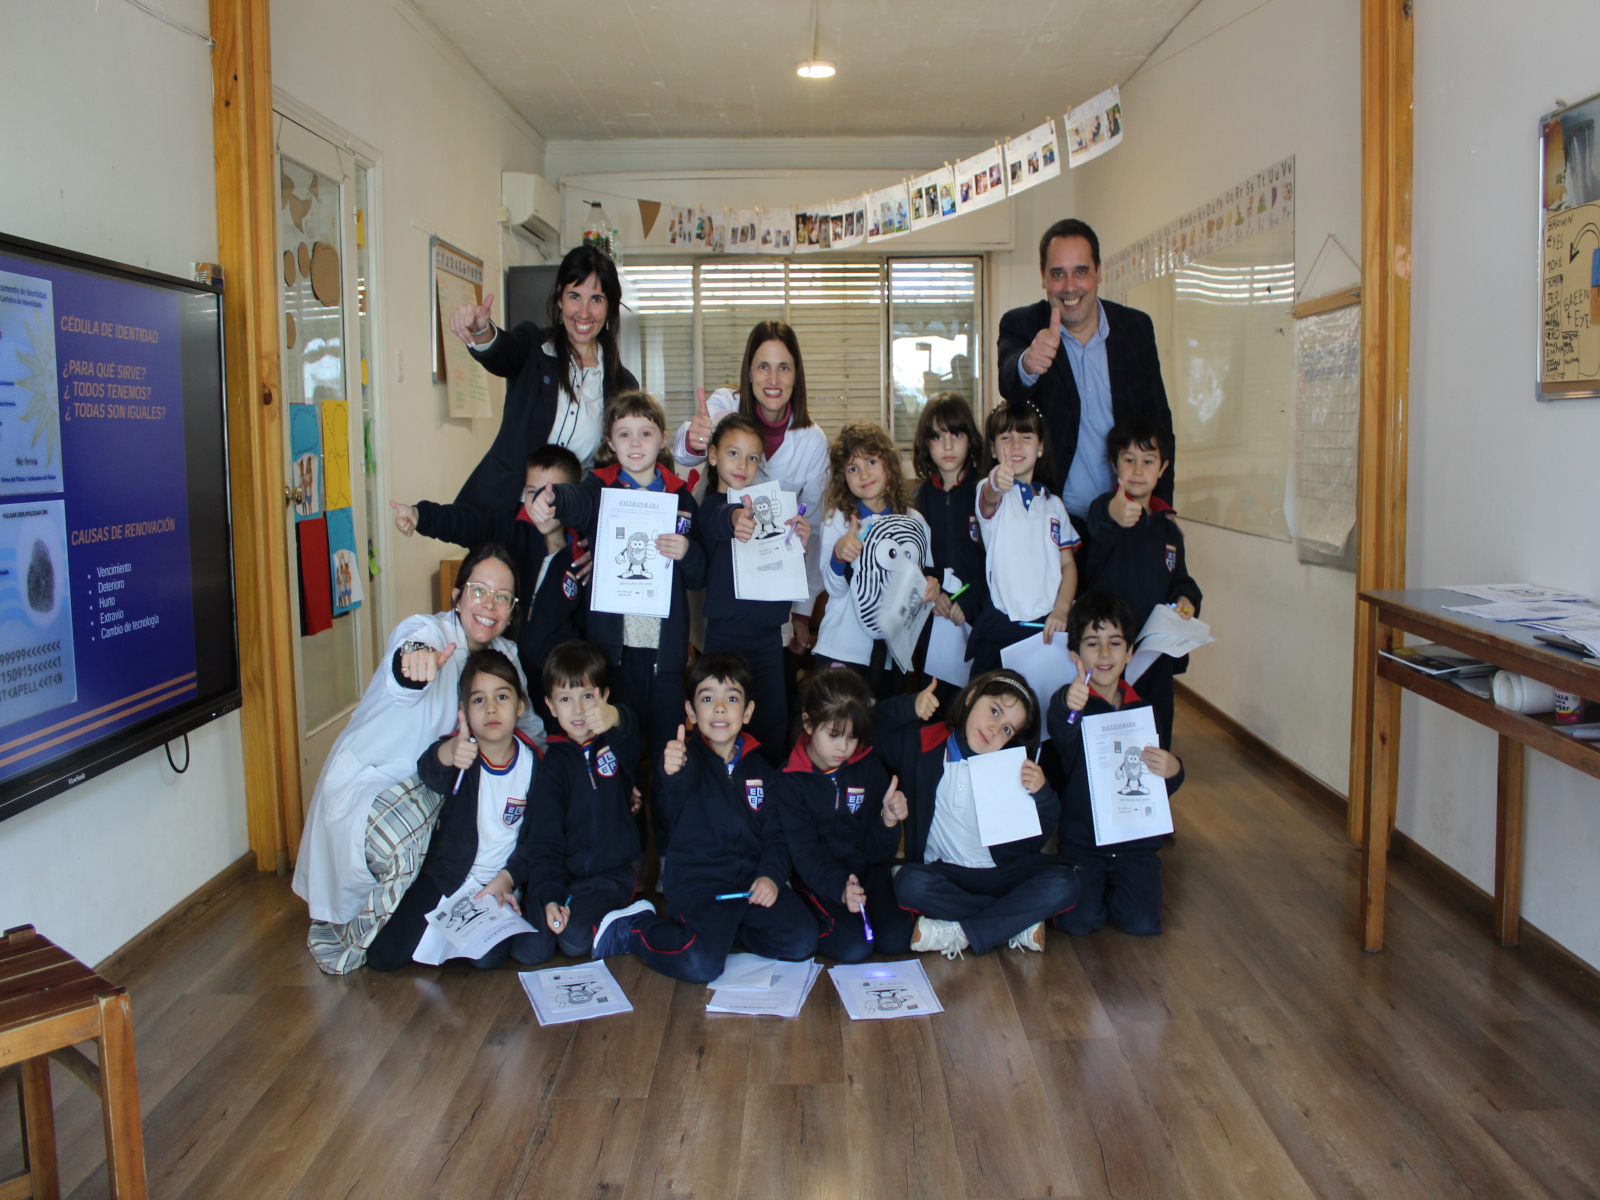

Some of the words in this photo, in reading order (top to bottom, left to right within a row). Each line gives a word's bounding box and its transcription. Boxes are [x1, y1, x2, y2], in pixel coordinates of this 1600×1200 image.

[1548, 214, 1573, 232] BROWN
[1546, 233, 1563, 250] EYES
[1564, 288, 1589, 312] GREEN
[1574, 310, 1592, 329] EYE
[60, 314, 99, 336] CÉDULA
[102, 322, 114, 337] DE
[115, 324, 159, 344] IDENTIDAD
[62, 359, 94, 378] ¿PARA
[96, 361, 115, 378] QUÉ
[117, 364, 146, 380] SIRVE?
[73, 381, 105, 398] TODOS
[107, 384, 151, 400] TENEMOS?
[74, 403, 105, 418] TODAS
[107, 404, 125, 418] SON
[127, 405, 166, 420] IGUALES?
[71, 527, 109, 546] CAUSAS
[111, 525, 123, 540] DE
[125, 516, 176, 538] RENOVACIÓN
[97, 562, 132, 578] Vencimiento
[98, 579, 125, 594] Deterioro
[99, 596, 116, 608] Hurto
[100, 609, 124, 624] Extravío
[101, 624, 123, 640] Cambio
[124, 621, 132, 633] de
[132, 614, 160, 632] tecnología
[68, 772, 86, 785] ViewSonic
